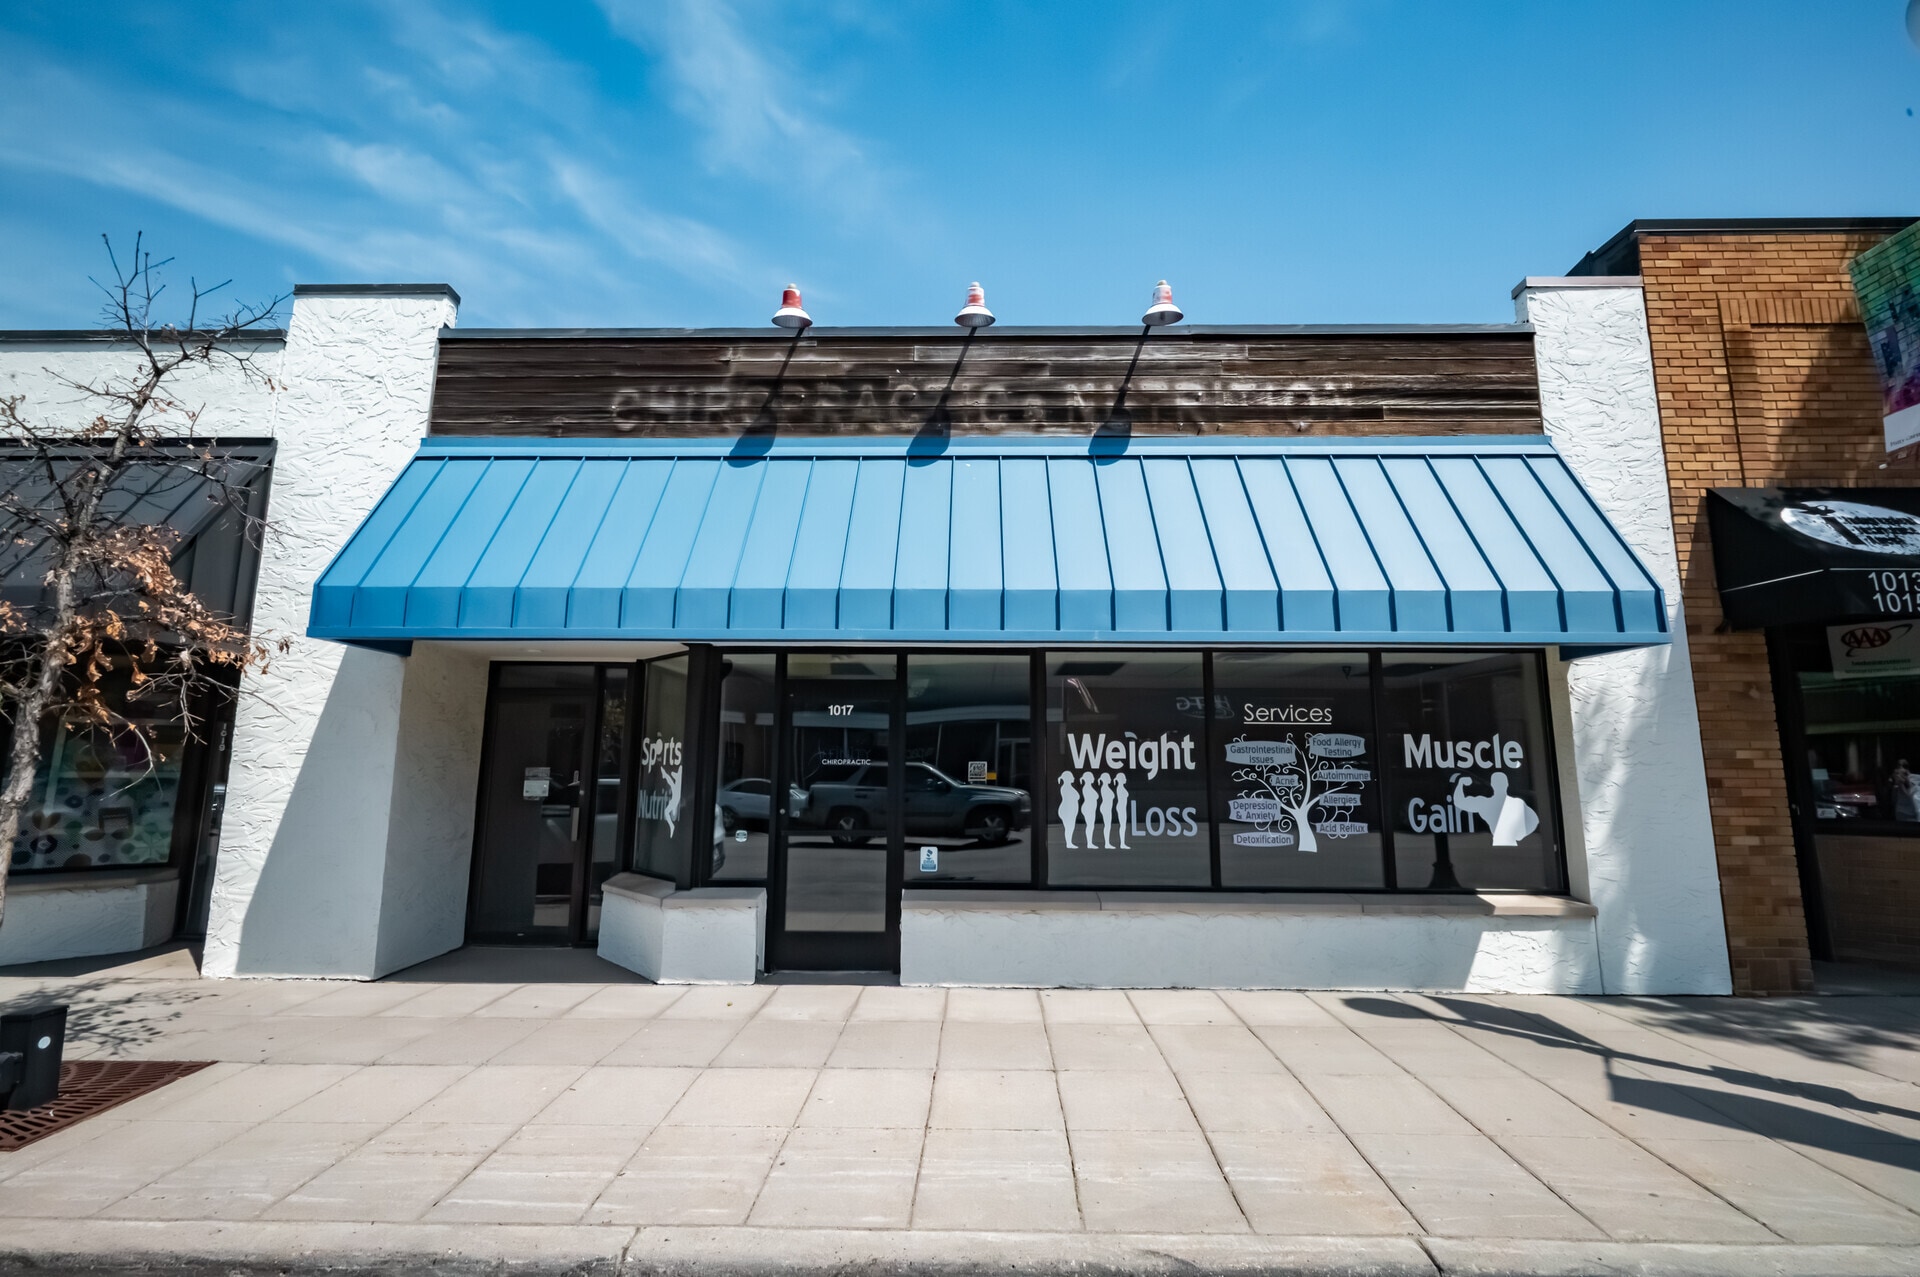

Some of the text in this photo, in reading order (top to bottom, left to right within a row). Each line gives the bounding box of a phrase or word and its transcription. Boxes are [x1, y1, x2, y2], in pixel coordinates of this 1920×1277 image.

[1872, 592, 1920, 613] 101
[1846, 628, 1889, 648] AAA
[827, 704, 854, 716] 1017
[1243, 703, 1333, 722] Services
[1312, 737, 1362, 749] Food Allergy
[1067, 731, 1197, 781] Weight
[1323, 747, 1353, 757] Testing
[1403, 733, 1524, 769] Muscle
[821, 758, 872, 766] CHIROPRACTIC
[1275, 776, 1295, 785] Acne
[1318, 770, 1370, 780] Autoimmune
[637, 788, 681, 822] Nutrit
[1233, 800, 1278, 811] Depression
[1323, 795, 1358, 805] Allergies
[1236, 811, 1276, 821] & Anxiety
[1407, 794, 1475, 834] Gain
[1319, 823, 1365, 833] Acid Reflux
[1236, 834, 1292, 844] Detoxification
